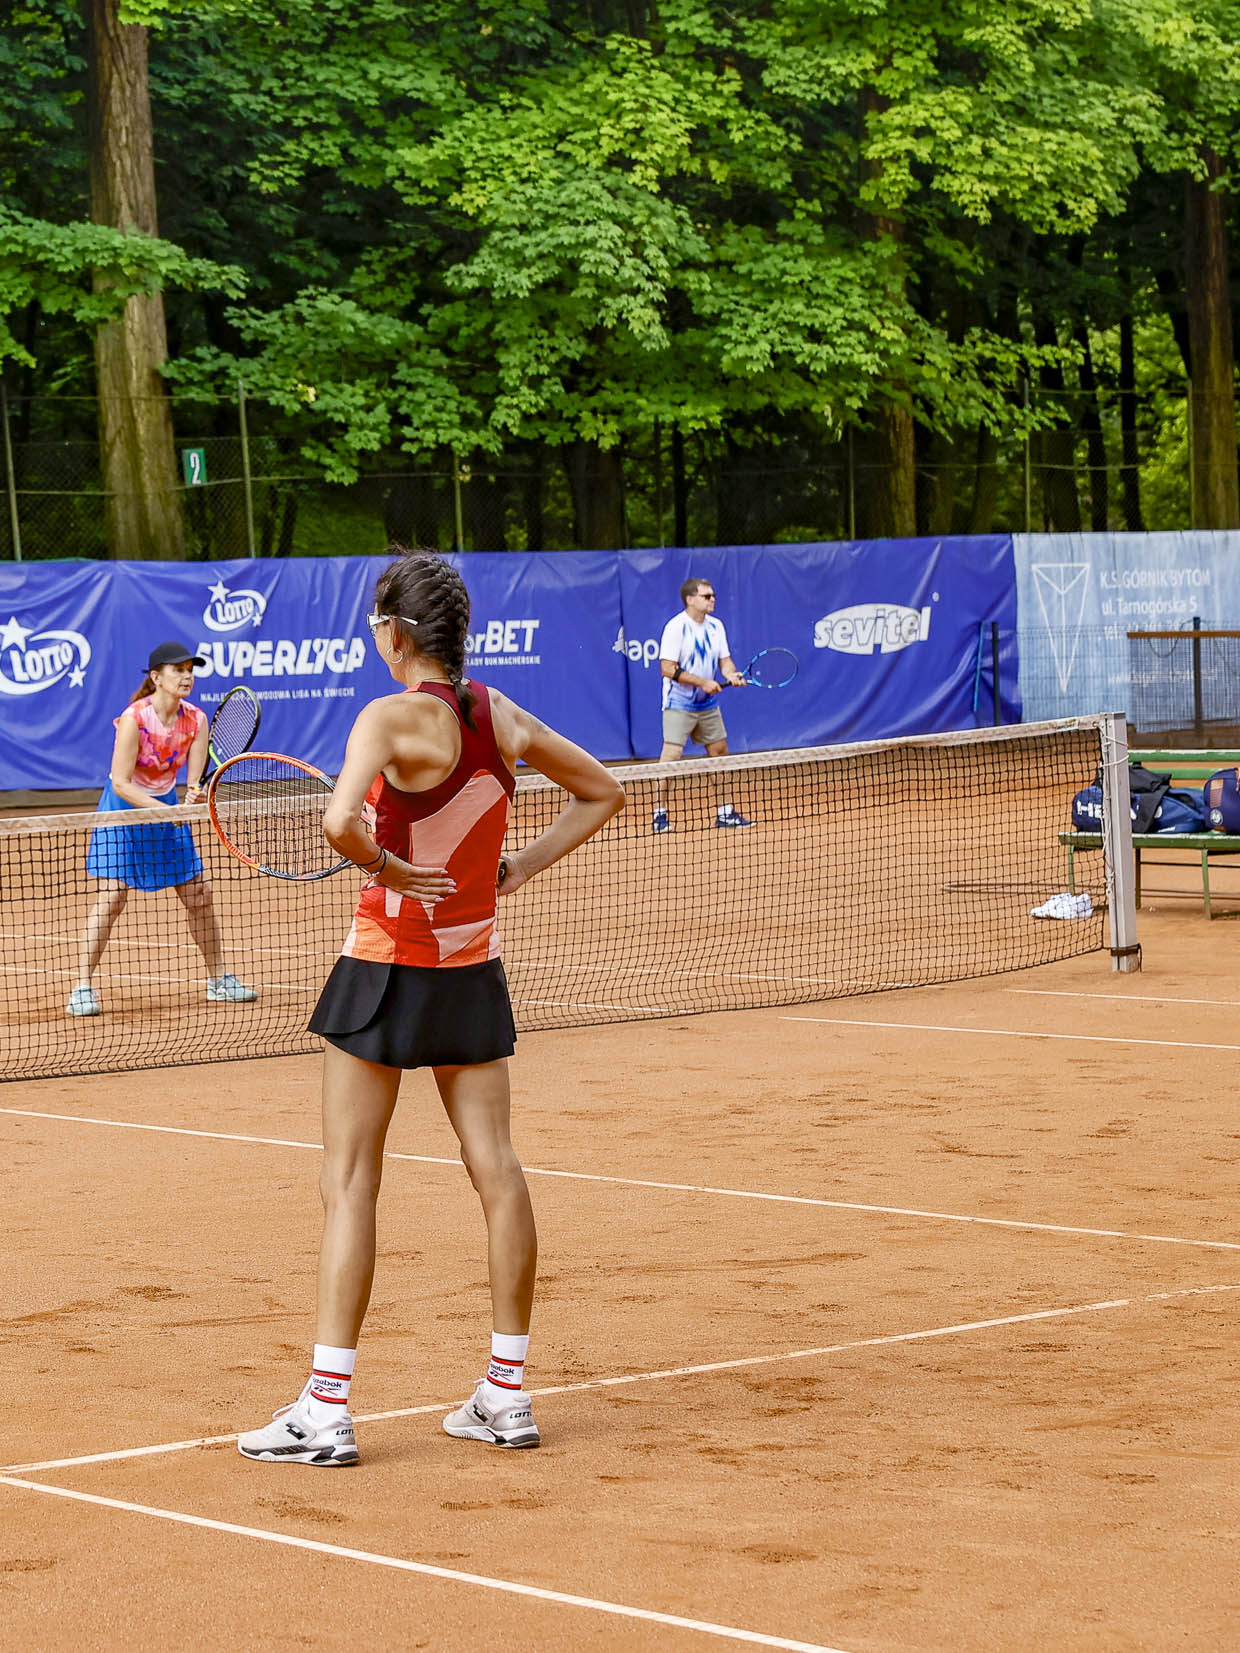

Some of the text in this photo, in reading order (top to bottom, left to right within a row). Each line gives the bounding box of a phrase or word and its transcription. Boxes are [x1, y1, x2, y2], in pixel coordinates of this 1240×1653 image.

[190, 453, 201, 485] 2
[215, 597, 255, 624] LOTTO
[1189, 595, 1198, 613] 5
[463, 620, 540, 654] orBET
[813, 606, 931, 649] sevitel
[8, 641, 74, 682] LOTTO
[192, 637, 366, 679] SUPERLIGA
